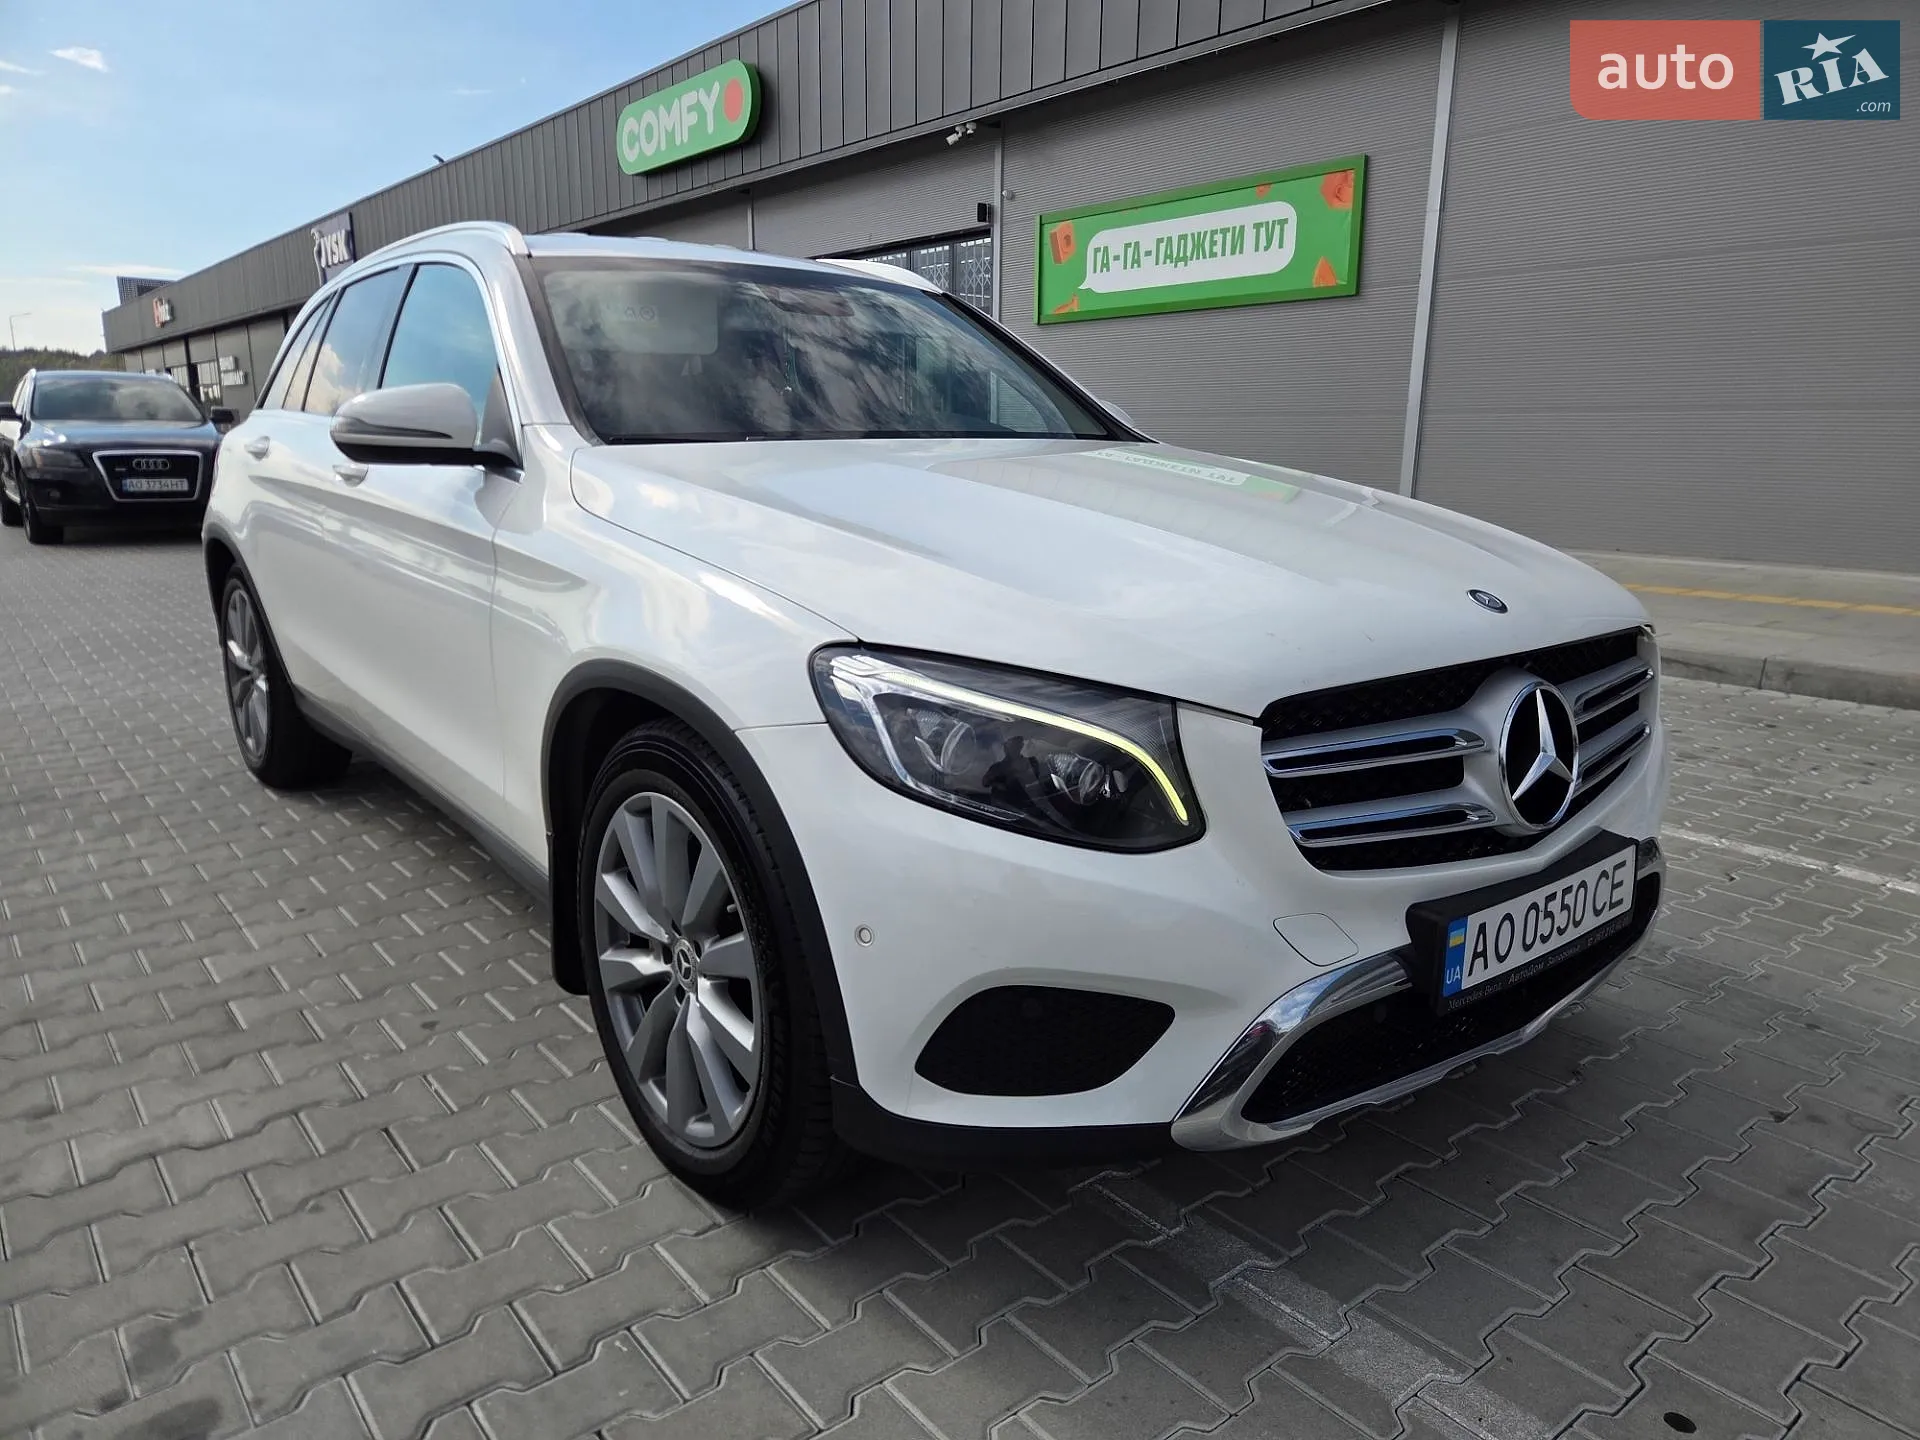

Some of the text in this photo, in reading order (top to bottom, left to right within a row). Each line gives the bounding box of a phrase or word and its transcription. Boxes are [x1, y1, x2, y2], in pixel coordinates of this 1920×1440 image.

[622, 81, 720, 162] COMFY
[320, 229, 349, 268] JYSK
[1252, 218, 1289, 253] ТУТ
[1467, 912, 1515, 977] AO
[1522, 879, 1588, 952] 0550
[1592, 859, 1627, 917] CE
[1445, 966, 1462, 985] UA
